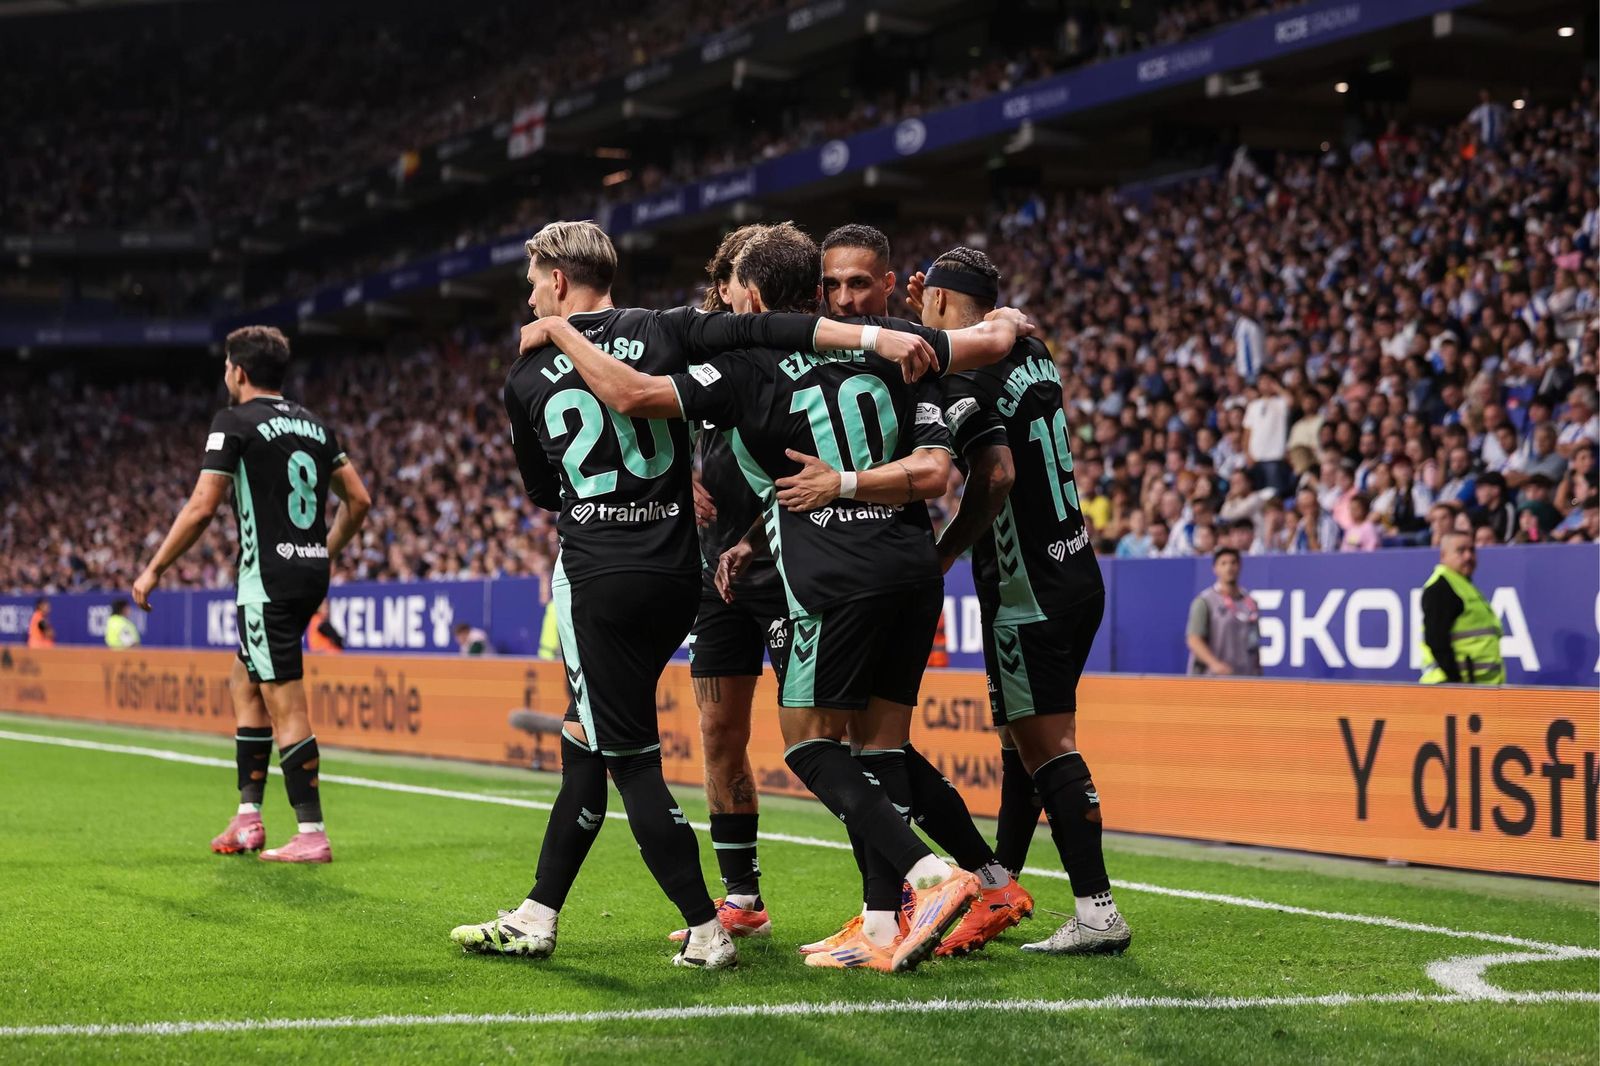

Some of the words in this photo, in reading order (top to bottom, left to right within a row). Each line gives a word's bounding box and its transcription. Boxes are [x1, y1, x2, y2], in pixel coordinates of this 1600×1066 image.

[540, 353, 574, 384] LO
[544, 388, 675, 499] 20
[789, 374, 899, 472] 10
[1029, 407, 1079, 522] 19
[287, 450, 317, 530] 8
[597, 501, 680, 522] trainline
[329, 595, 426, 648] KELME
[1257, 587, 1541, 672] SKOA
[1338, 717, 1386, 821] Y
[1412, 714, 1599, 842] disfr
